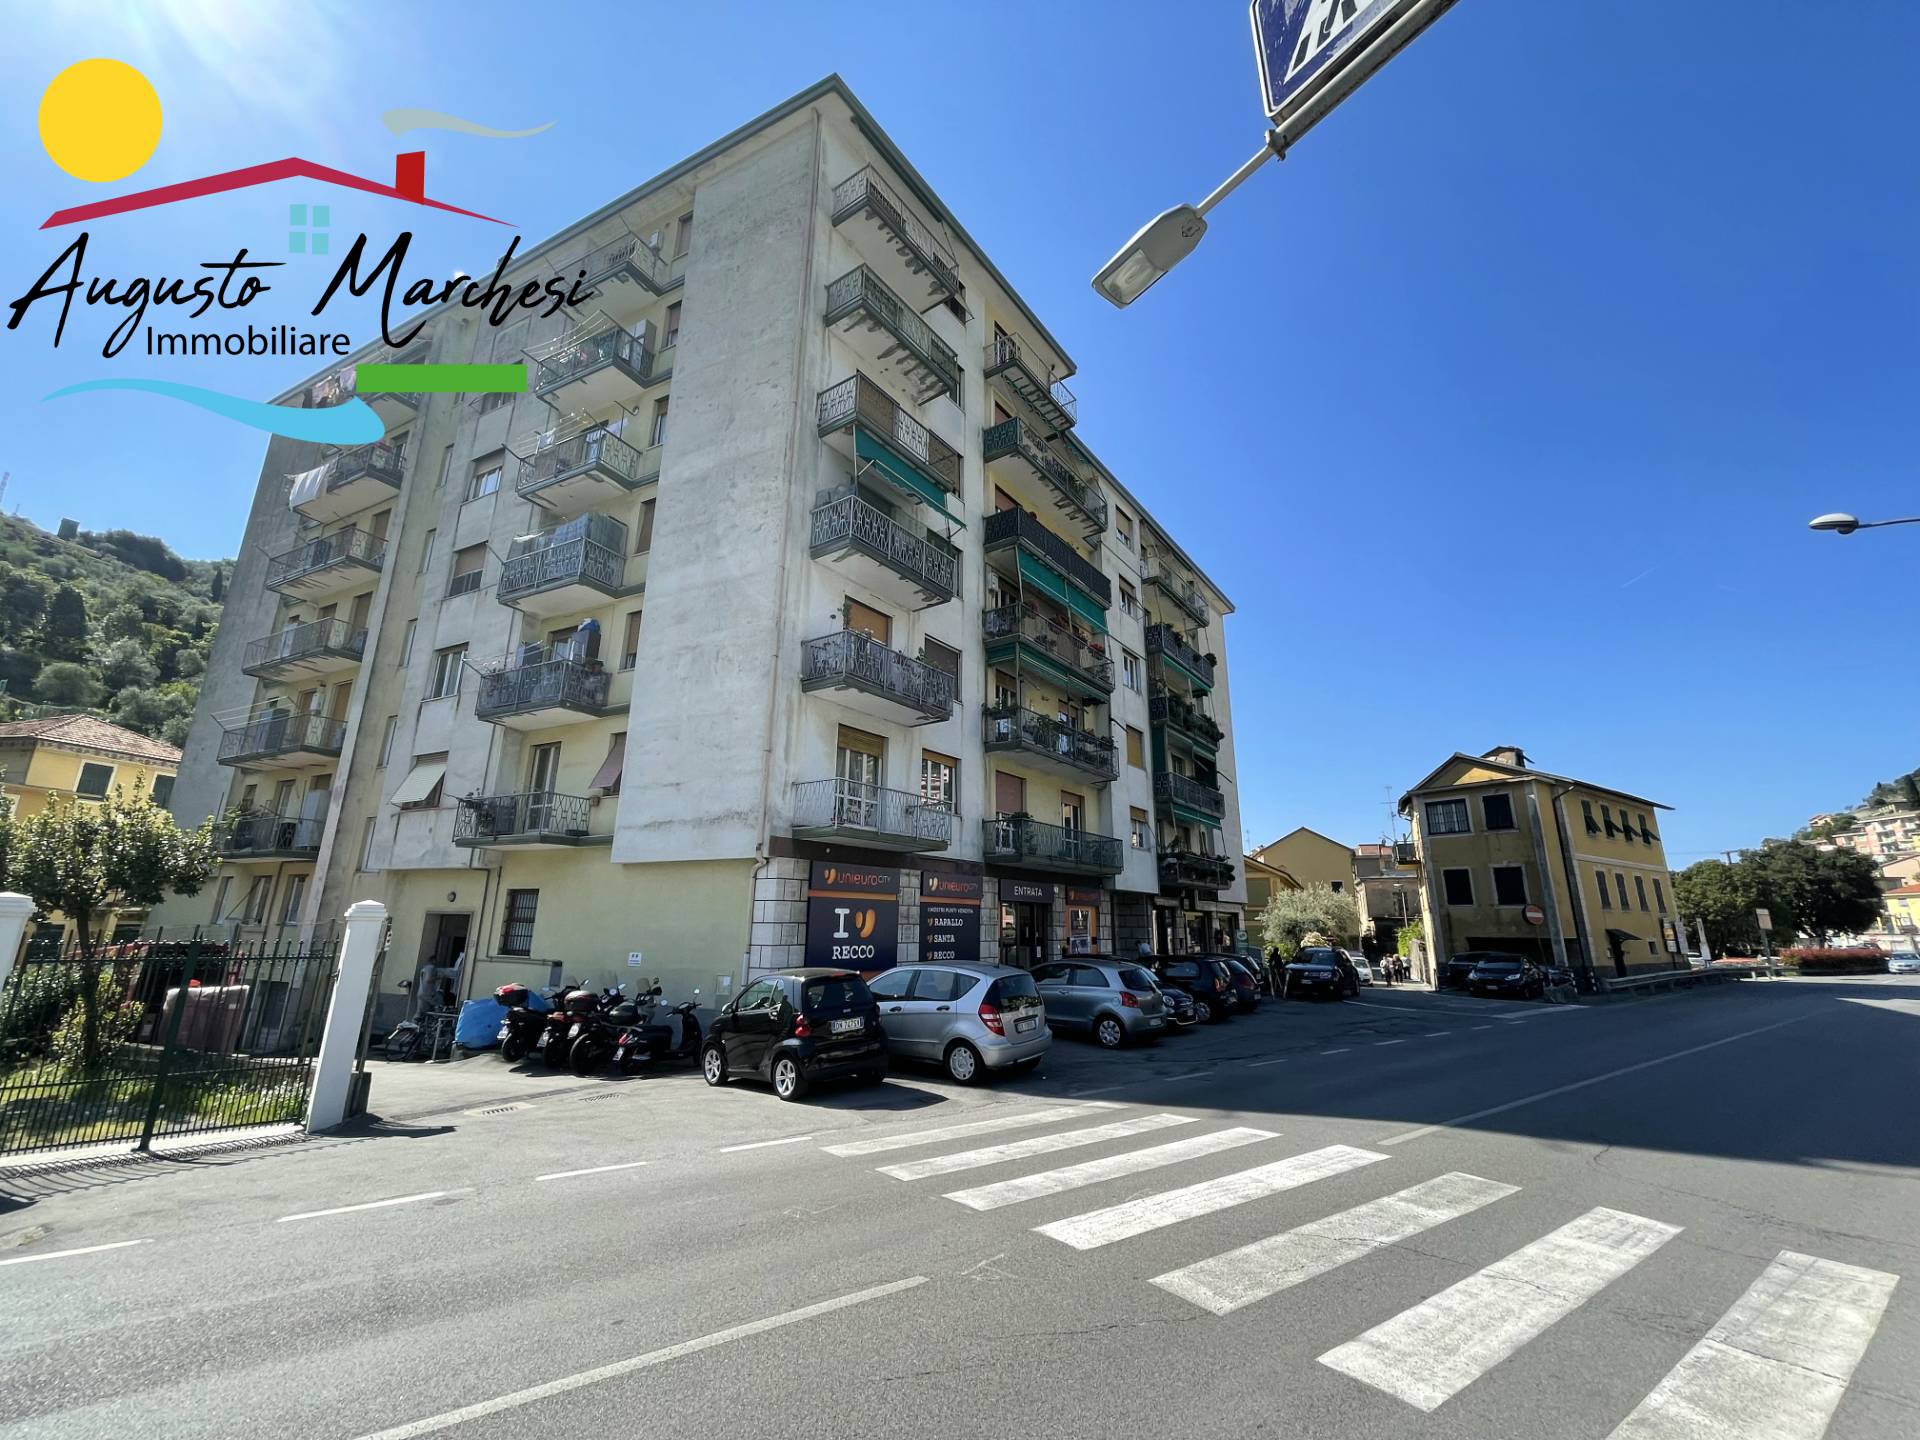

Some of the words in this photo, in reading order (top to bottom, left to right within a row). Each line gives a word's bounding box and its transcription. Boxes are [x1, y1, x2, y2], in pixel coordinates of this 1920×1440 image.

[1014, 886, 1043, 897] ENTRATA
[833, 907, 850, 939] I
[934, 918, 964, 927] RAPALLO
[933, 934, 956, 943] SANTA
[832, 945, 875, 960] RECCO
[933, 951, 955, 960] RECCO
